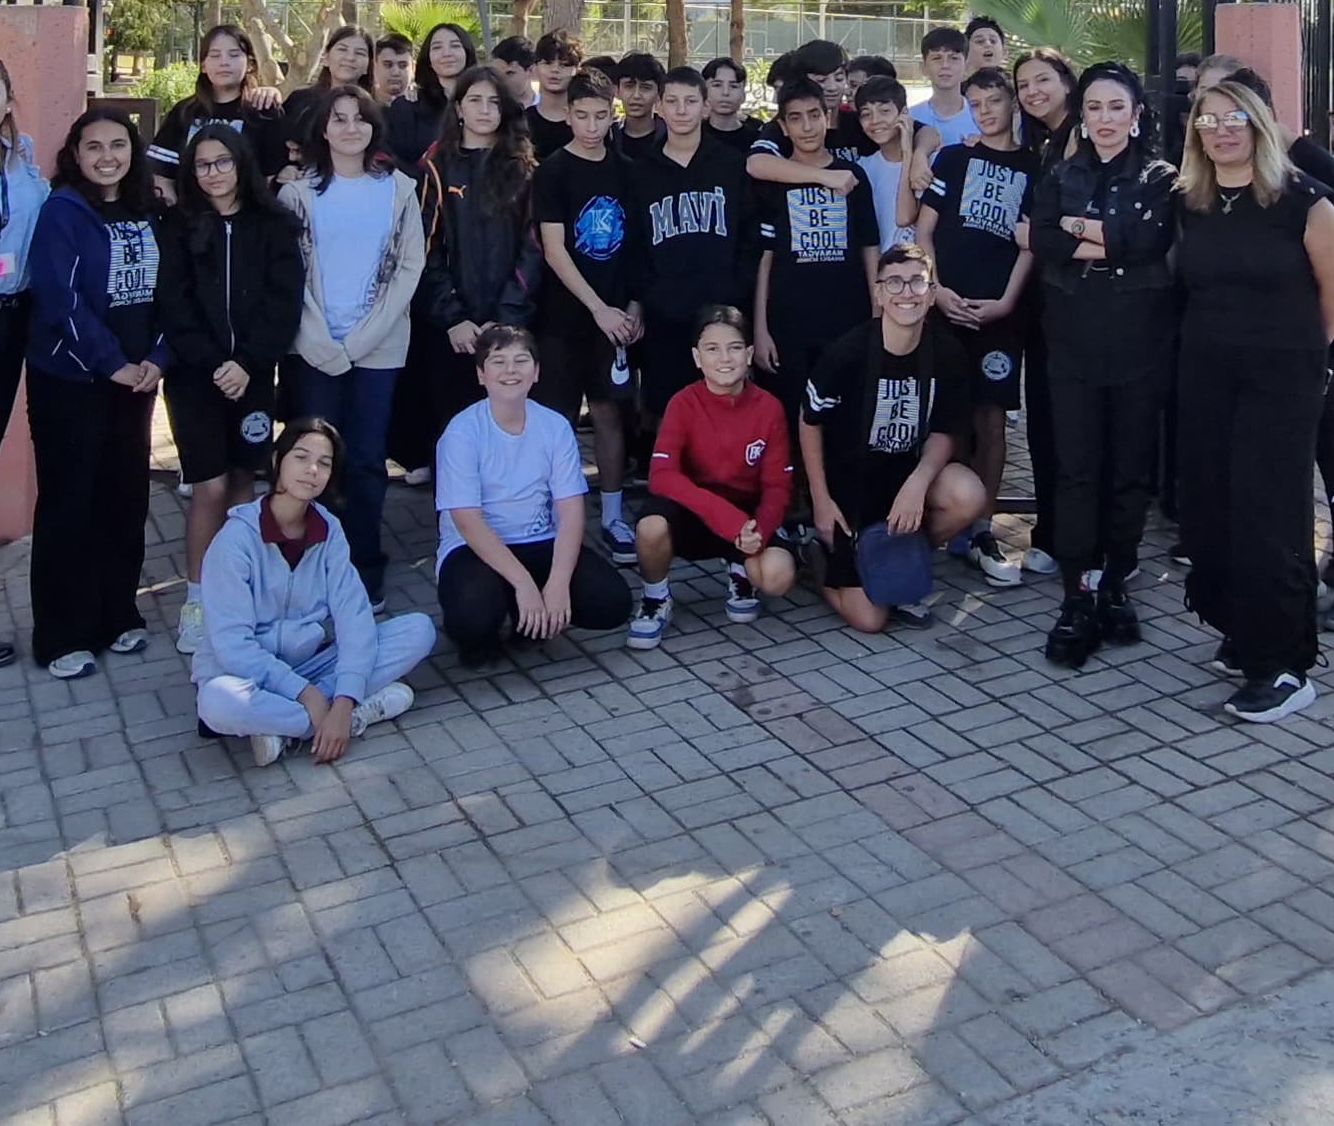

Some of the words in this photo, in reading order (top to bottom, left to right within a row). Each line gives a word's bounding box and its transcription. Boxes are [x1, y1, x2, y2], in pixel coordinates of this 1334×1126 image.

[977, 160, 1016, 185] JUST
[983, 182, 1006, 202] BE
[809, 208, 830, 227] BE
[800, 230, 839, 249] COOL
[123, 243, 142, 265] BE
[890, 400, 910, 420] BE
